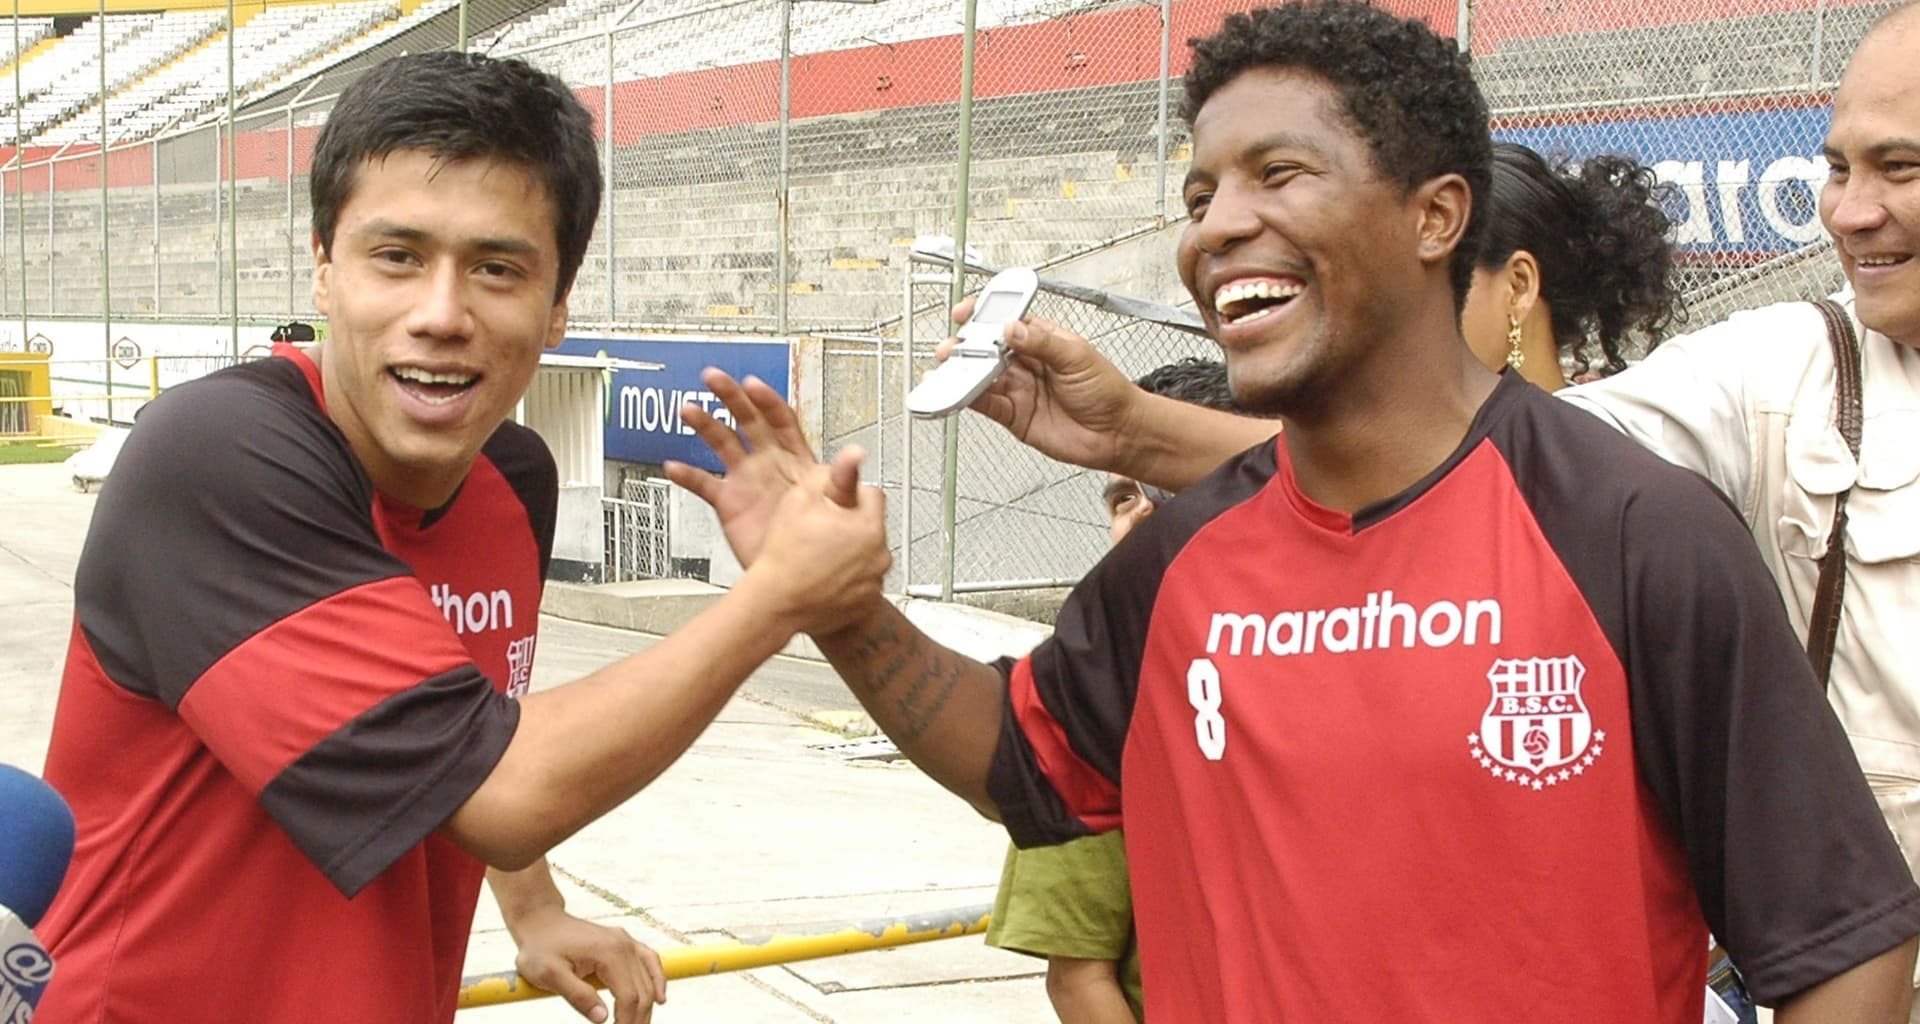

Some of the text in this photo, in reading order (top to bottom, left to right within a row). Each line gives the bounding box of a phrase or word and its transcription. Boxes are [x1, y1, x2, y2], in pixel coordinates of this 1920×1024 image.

[1206, 590, 1502, 656] marathon
[1187, 658, 1226, 761] 8
[1501, 695, 1574, 715] B.S.C.
